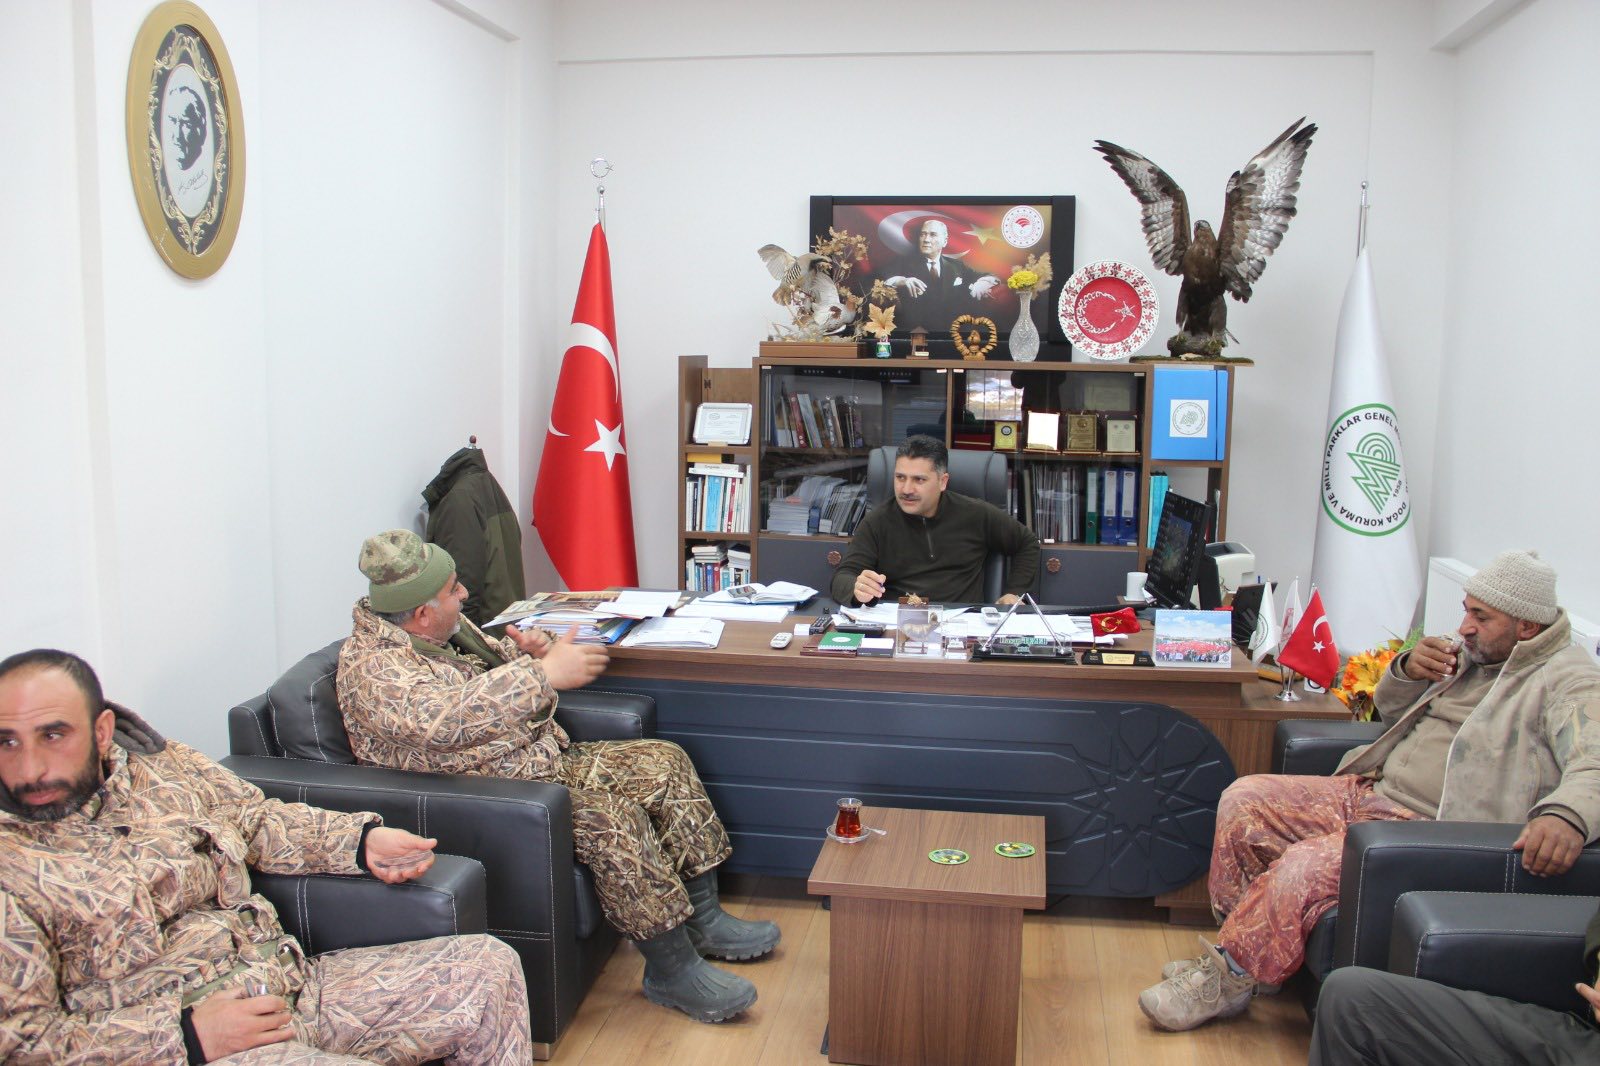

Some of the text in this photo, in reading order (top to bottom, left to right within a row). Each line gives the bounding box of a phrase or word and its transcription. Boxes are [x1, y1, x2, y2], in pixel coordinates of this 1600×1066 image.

[1365, 412, 1393, 427] GENEL
[1327, 415, 1361, 457] PARKLAR
[1328, 493, 1338, 507] VE
[1340, 506, 1384, 527] KORUMA
